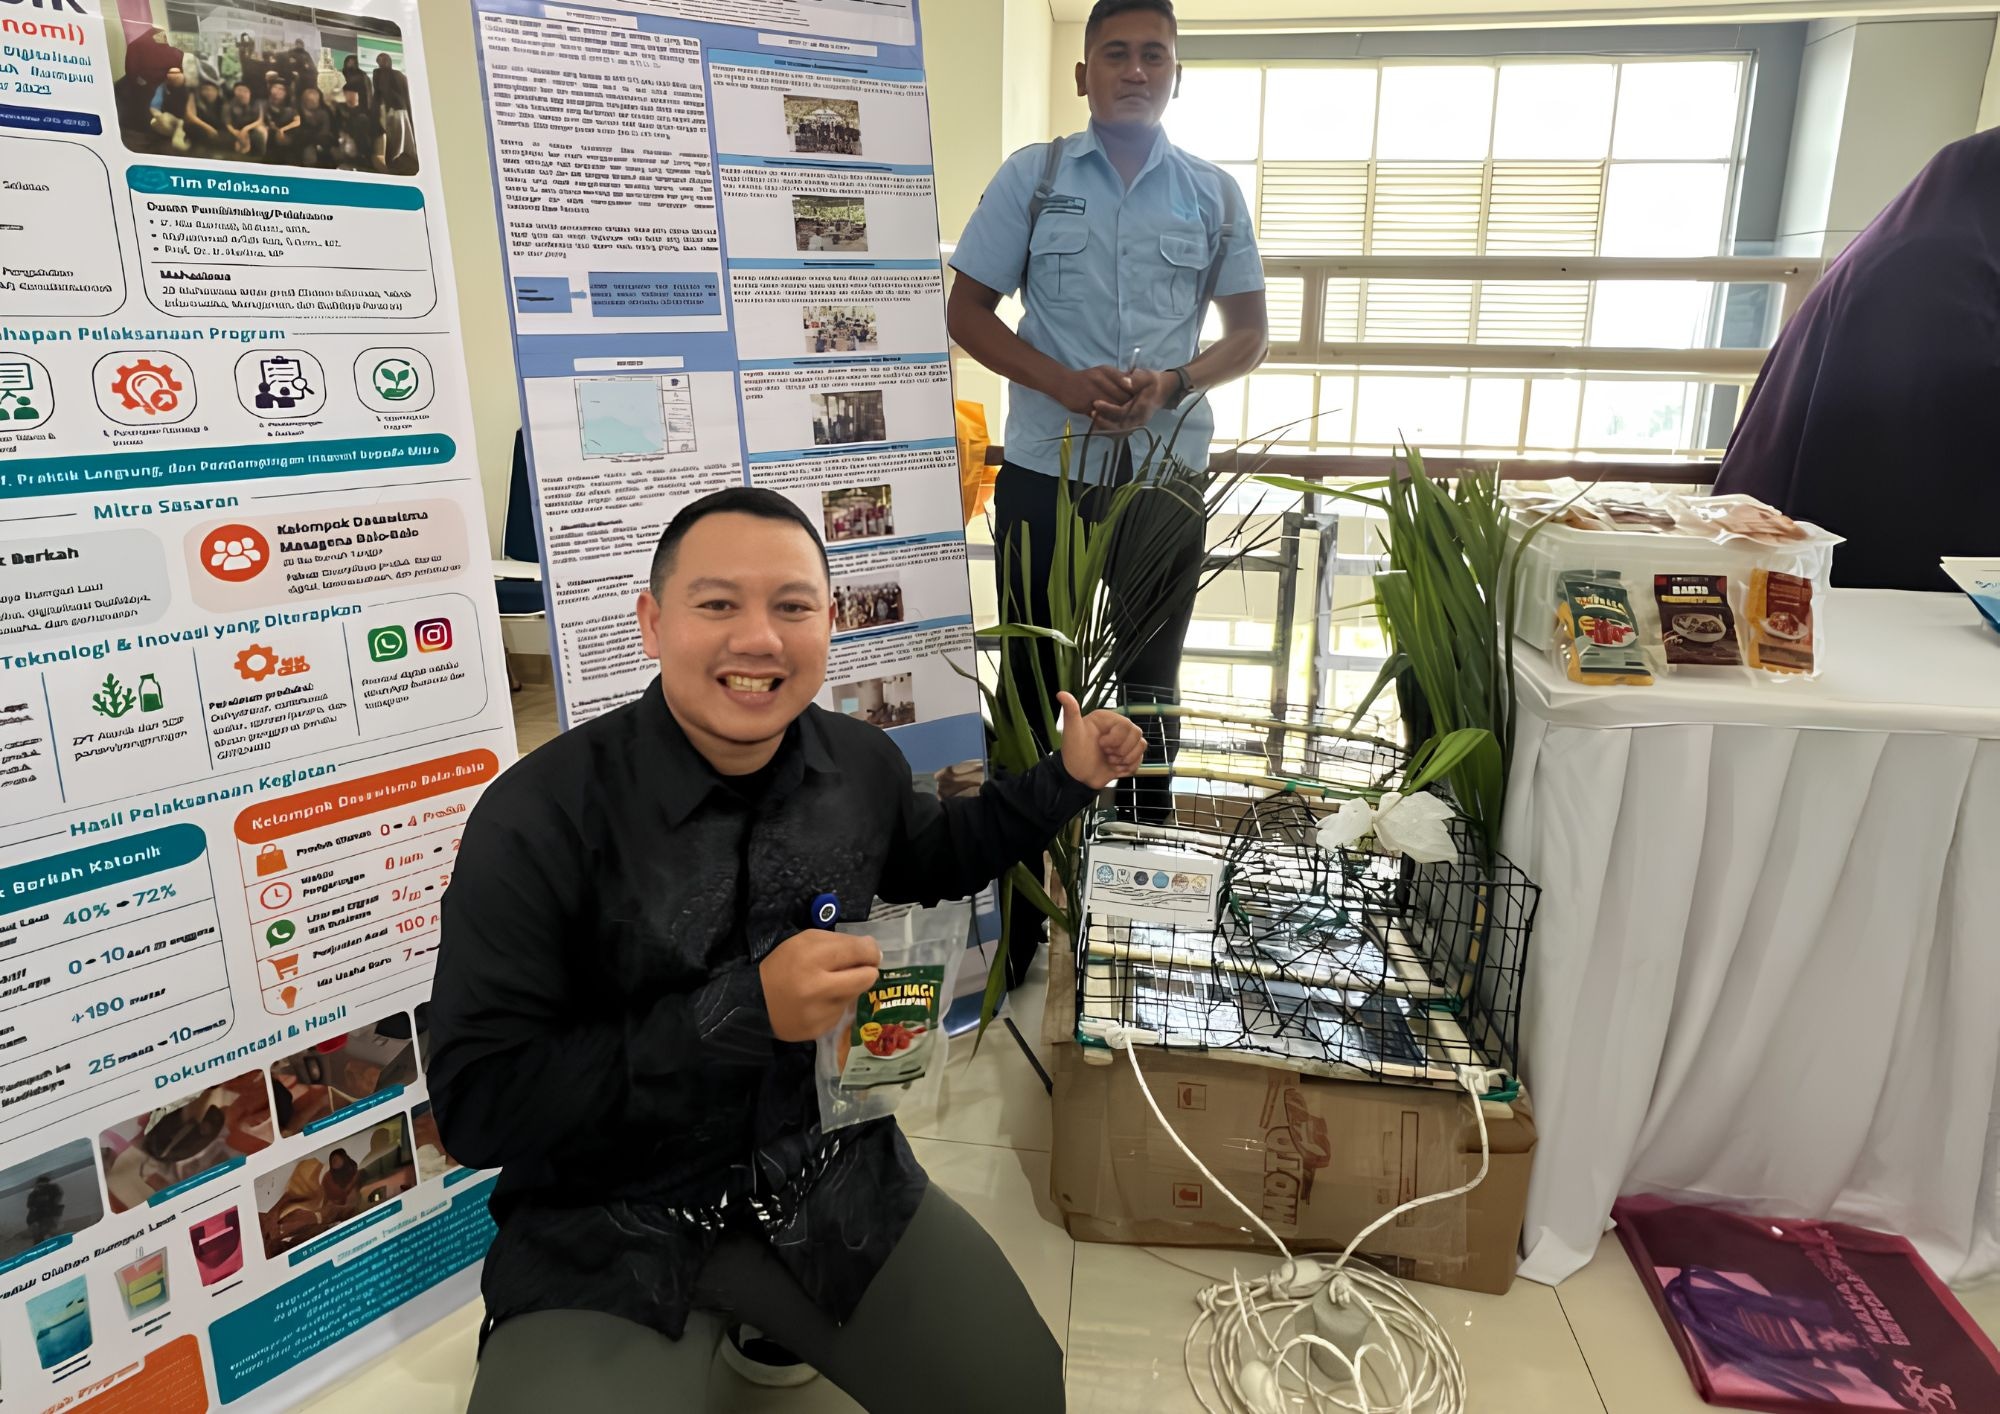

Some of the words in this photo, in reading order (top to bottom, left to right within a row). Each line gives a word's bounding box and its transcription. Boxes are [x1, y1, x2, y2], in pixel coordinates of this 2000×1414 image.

[170, 176, 201, 189] Tim
[0, 327, 72, 344] hapan
[210, 327, 286, 343] Program
[94, 502, 153, 519] Mitra
[158, 496, 239, 513] Sasaran
[277, 517, 350, 534] Kelompok
[215, 619, 260, 639] yang
[70, 813, 123, 836] Hasil
[63, 902, 110, 925] 40%
[133, 883, 176, 907] 72%
[100, 947, 125, 964] 10
[154, 1030, 282, 1089] Dokumentasi
